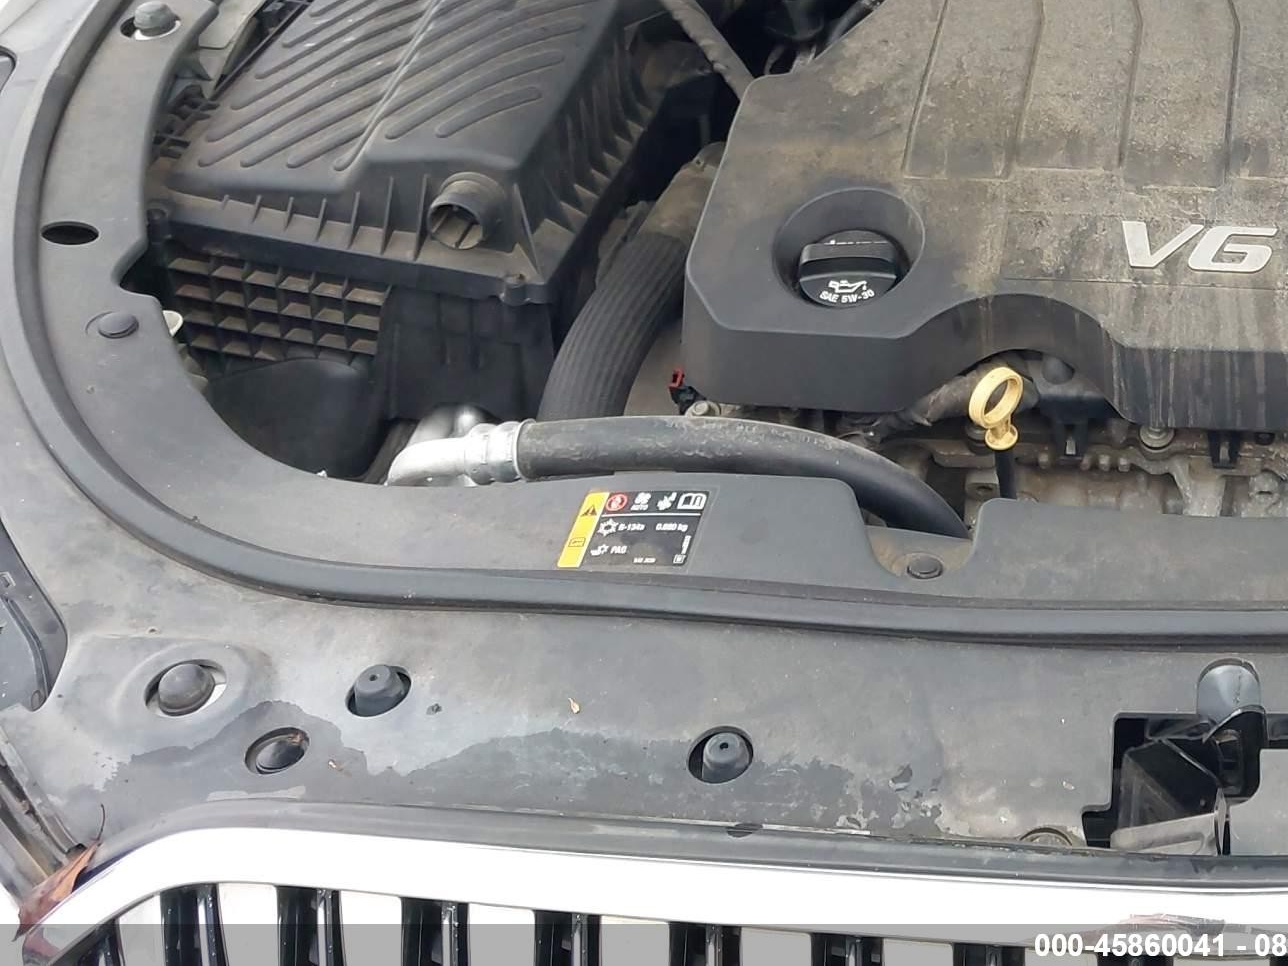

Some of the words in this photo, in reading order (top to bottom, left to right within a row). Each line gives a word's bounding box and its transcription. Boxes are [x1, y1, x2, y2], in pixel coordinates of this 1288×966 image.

[1121, 220, 1279, 273] V6
[819, 290, 839, 303] SAE
[840, 288, 875, 304] 5W-30
